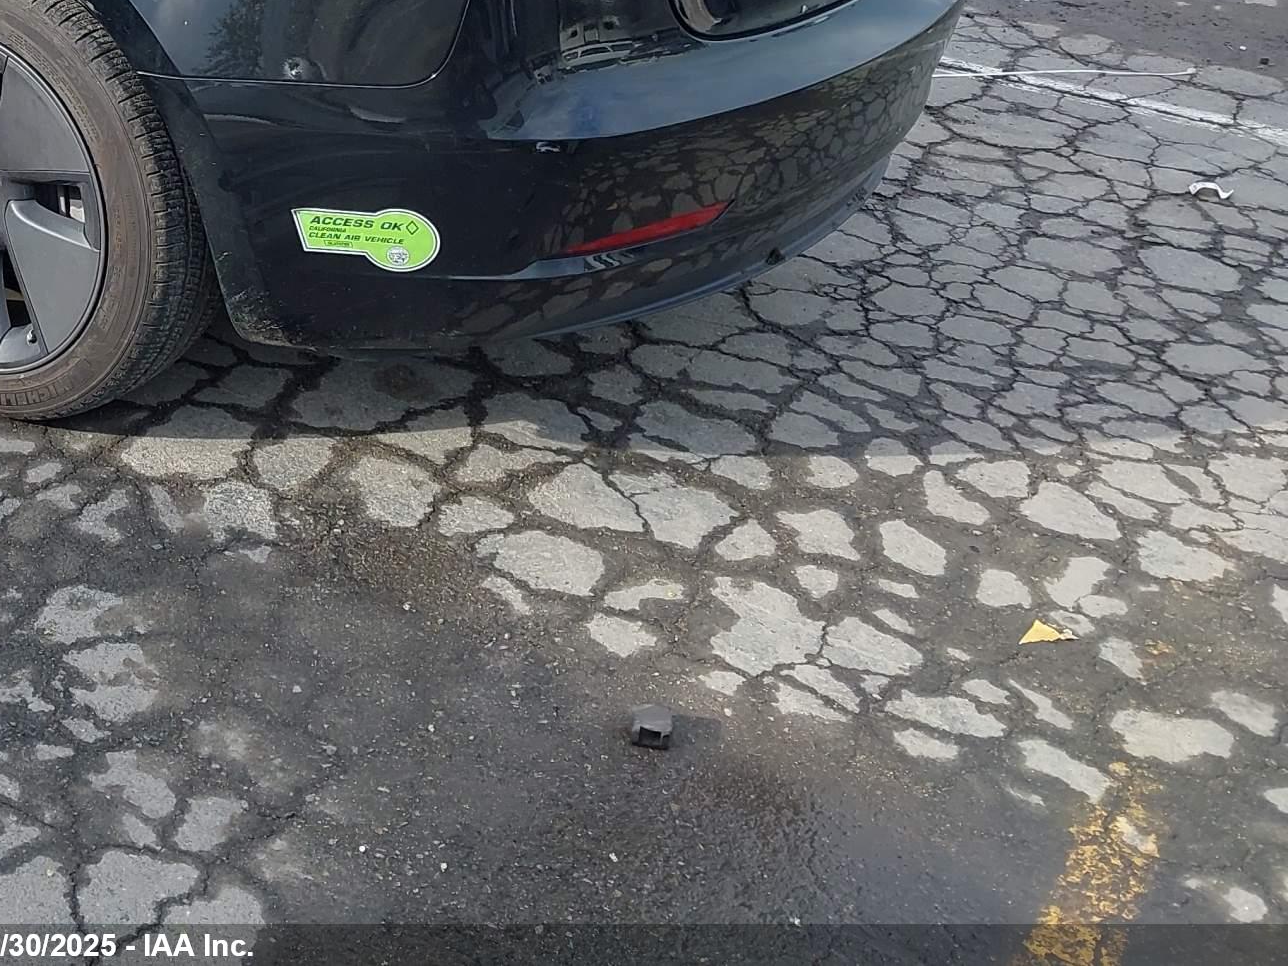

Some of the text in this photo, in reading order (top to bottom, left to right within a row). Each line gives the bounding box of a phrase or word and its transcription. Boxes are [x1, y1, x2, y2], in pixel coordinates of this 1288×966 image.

[309, 225, 347, 233] CALIFORNIA
[310, 215, 404, 231] ACCESS OK
[308, 231, 342, 240] CLEAN
[364, 236, 405, 245] VEHICLE
